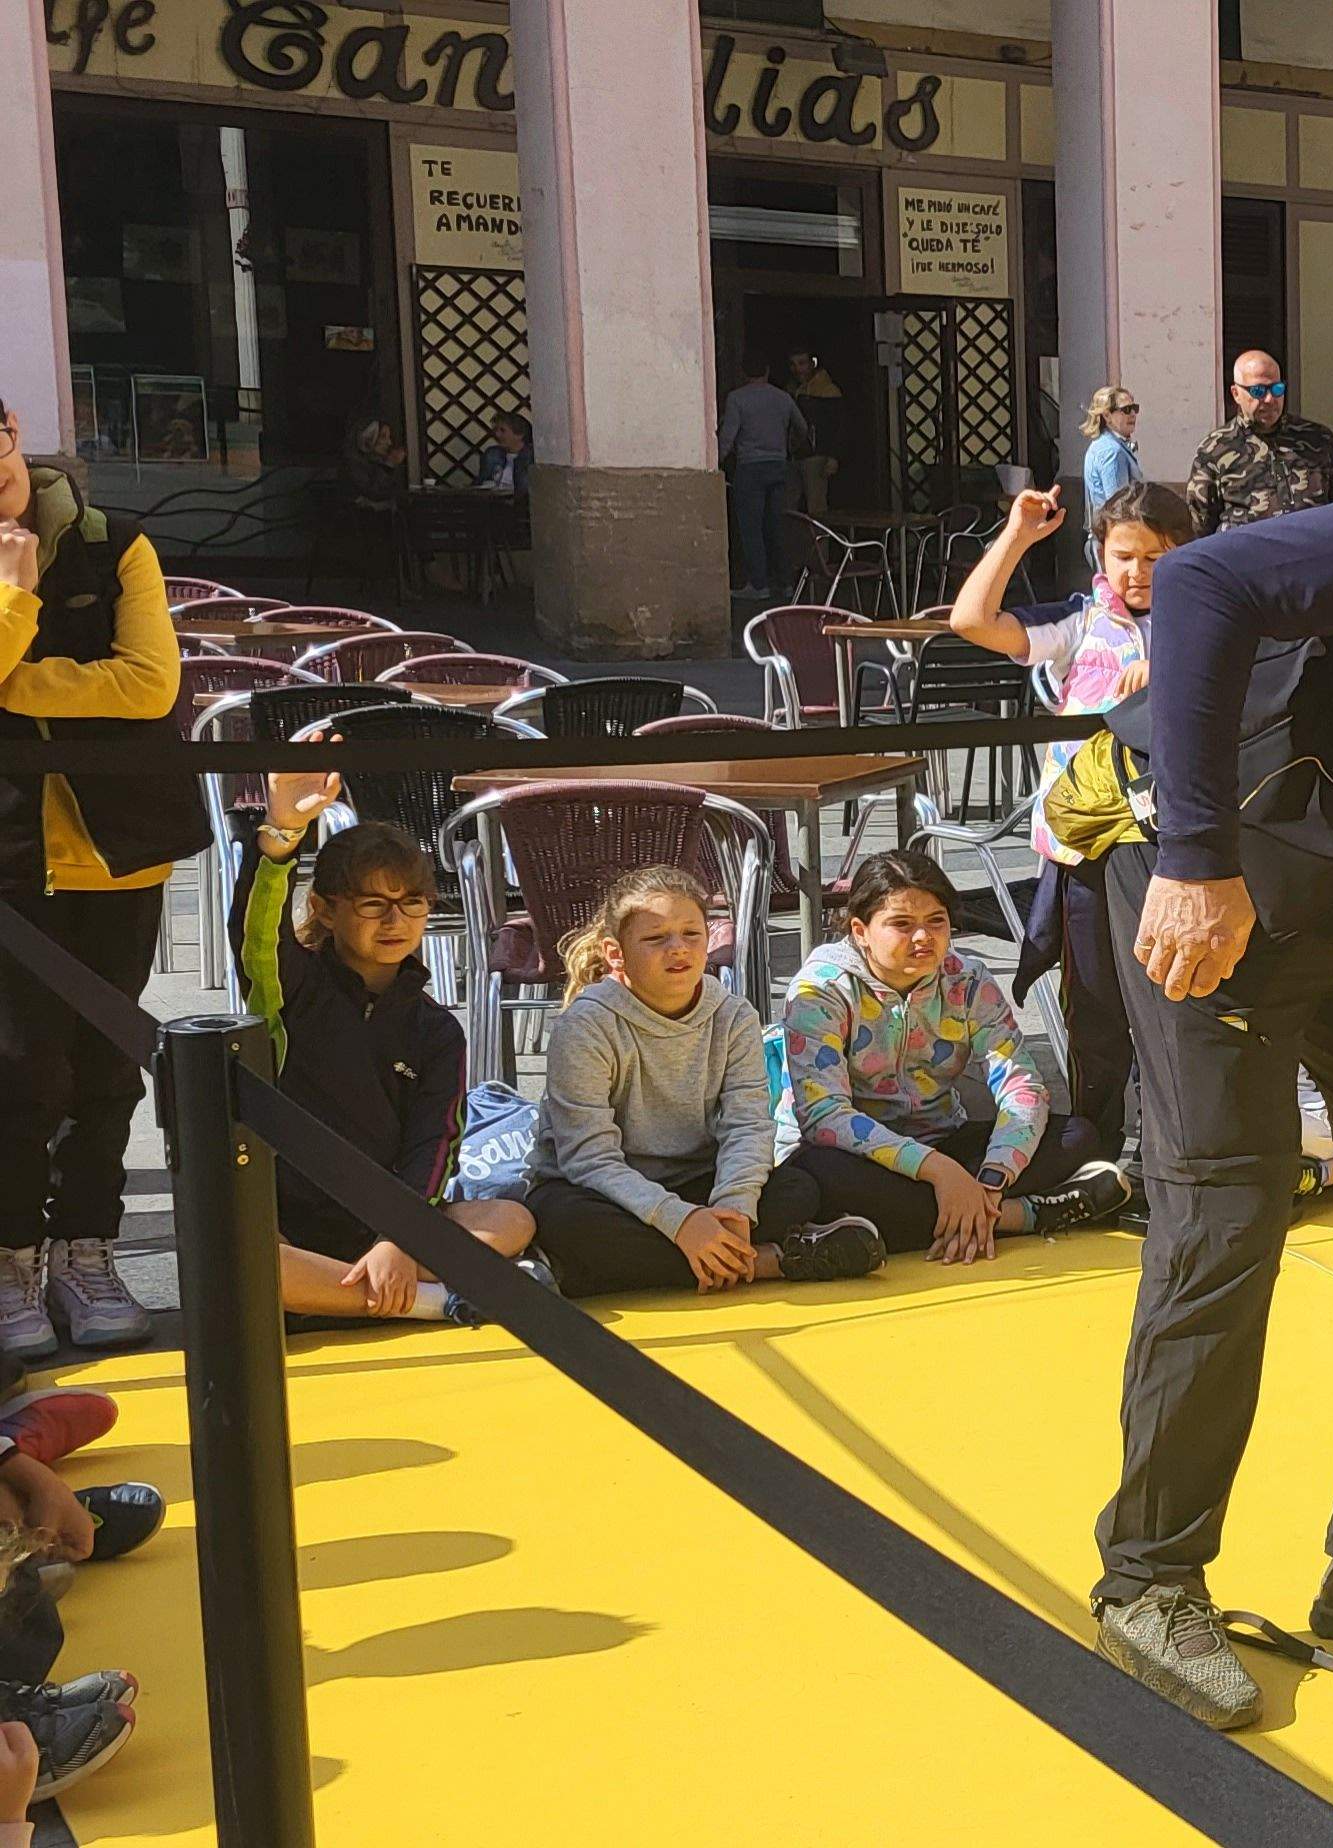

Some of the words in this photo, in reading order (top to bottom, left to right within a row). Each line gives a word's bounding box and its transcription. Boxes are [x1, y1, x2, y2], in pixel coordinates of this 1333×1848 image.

[422, 160, 452, 177] TE
[429, 189, 521, 213] RECUER
[904, 197, 925, 213] ME
[957, 202, 971, 214] UN
[972, 200, 1000, 216] CAFÉ
[436, 213, 523, 236] AMAND
[906, 217, 915, 231] Y
[920, 219, 934, 232] LE
[938, 257, 995, 275] HERMOSO!
